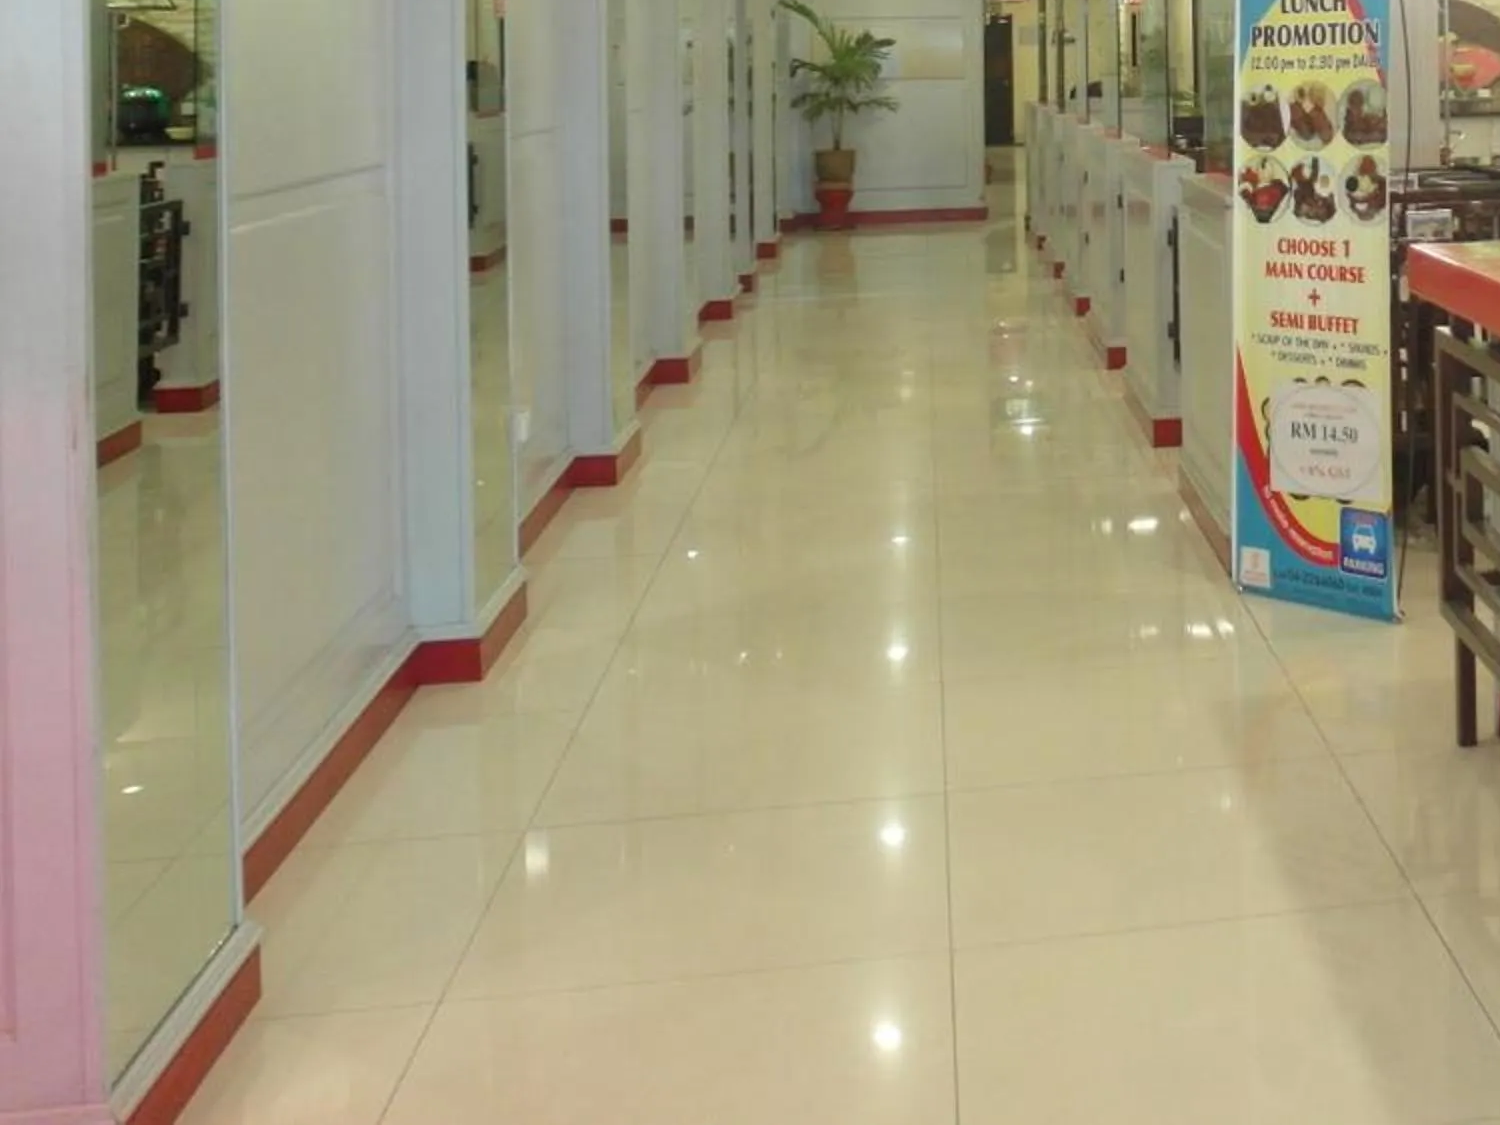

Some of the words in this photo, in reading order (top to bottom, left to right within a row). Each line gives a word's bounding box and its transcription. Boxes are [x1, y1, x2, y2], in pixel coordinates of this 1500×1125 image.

[1251, 21, 1380, 48] PROMOTION
[1277, 237, 1337, 258] CHOOSE
[1342, 239, 1351, 258] 1
[1265, 261, 1303, 280] MAIN
[1306, 263, 1366, 284] COURSE
[1270, 310, 1303, 329] SEMI
[1307, 313, 1360, 335] BUFFET
[1290, 421, 1317, 441] RM
[1321, 423, 1360, 444] 14.50
